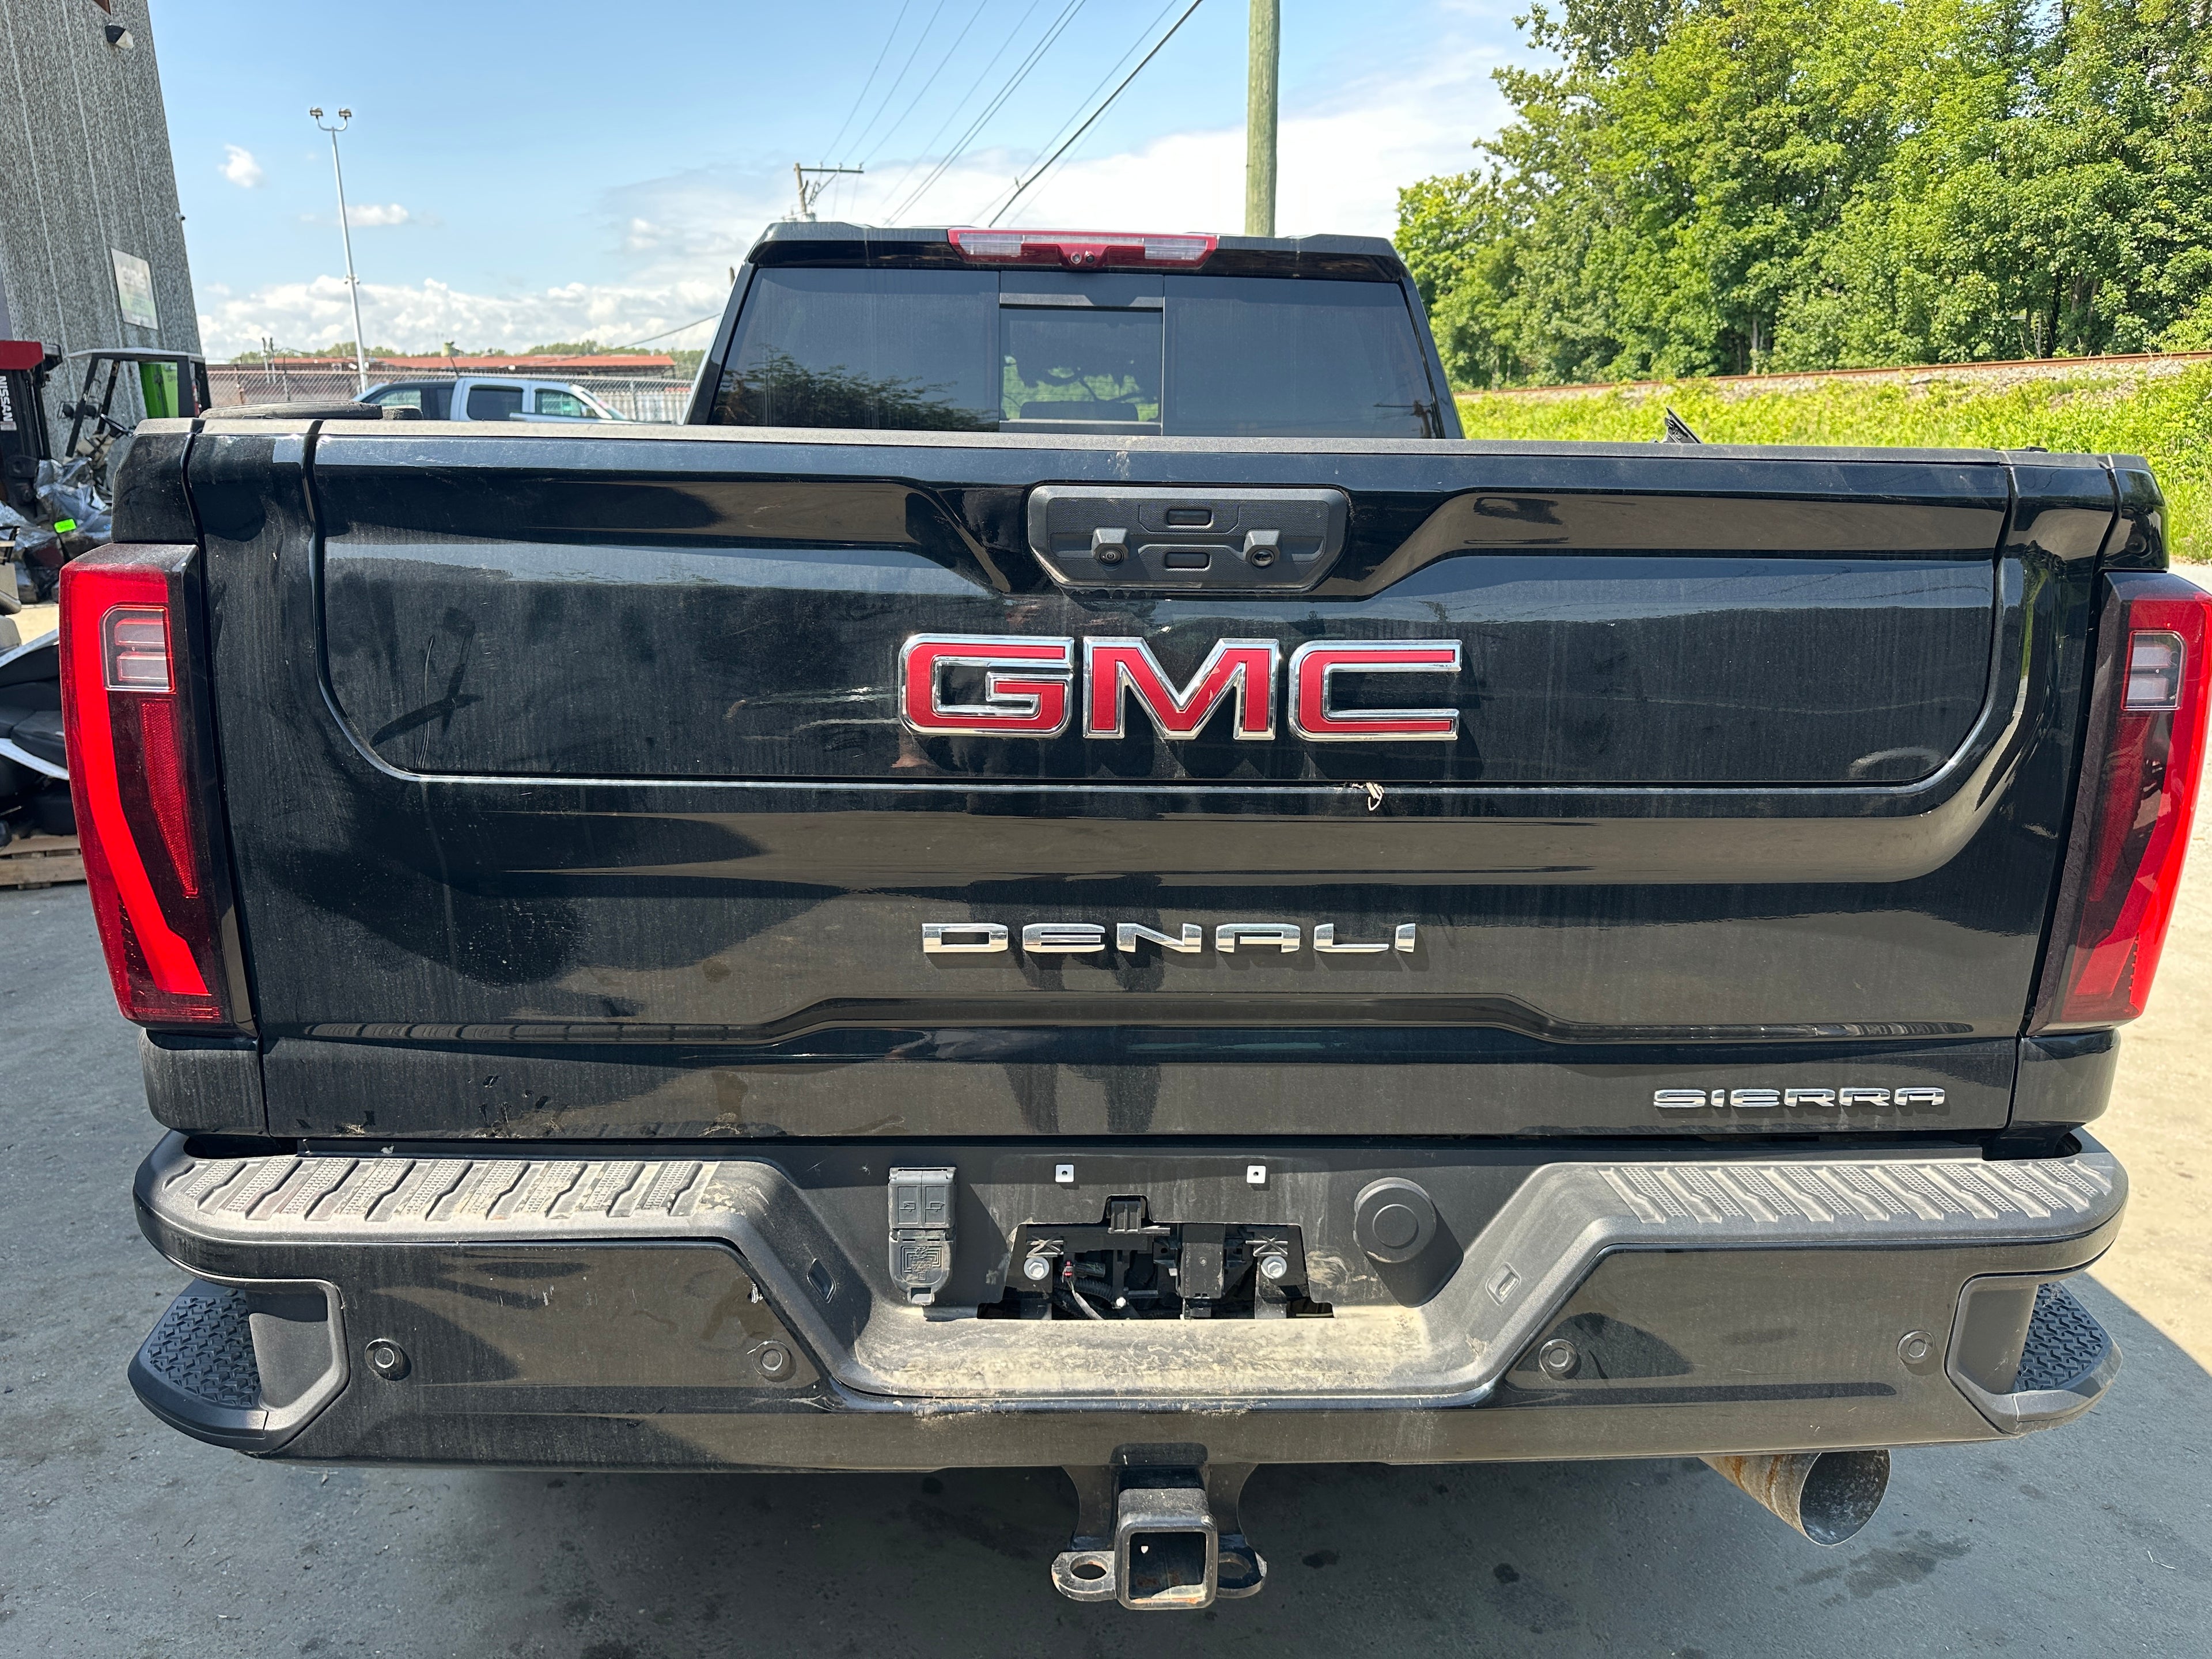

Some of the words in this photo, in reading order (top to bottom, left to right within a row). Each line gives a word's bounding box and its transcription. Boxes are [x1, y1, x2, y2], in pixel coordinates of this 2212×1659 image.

[0, 375, 13, 422] NISSAN
[897, 633, 1463, 742] GMC
[921, 922, 1416, 953] DENALI
[1653, 1088, 1945, 1108] SIERRA
